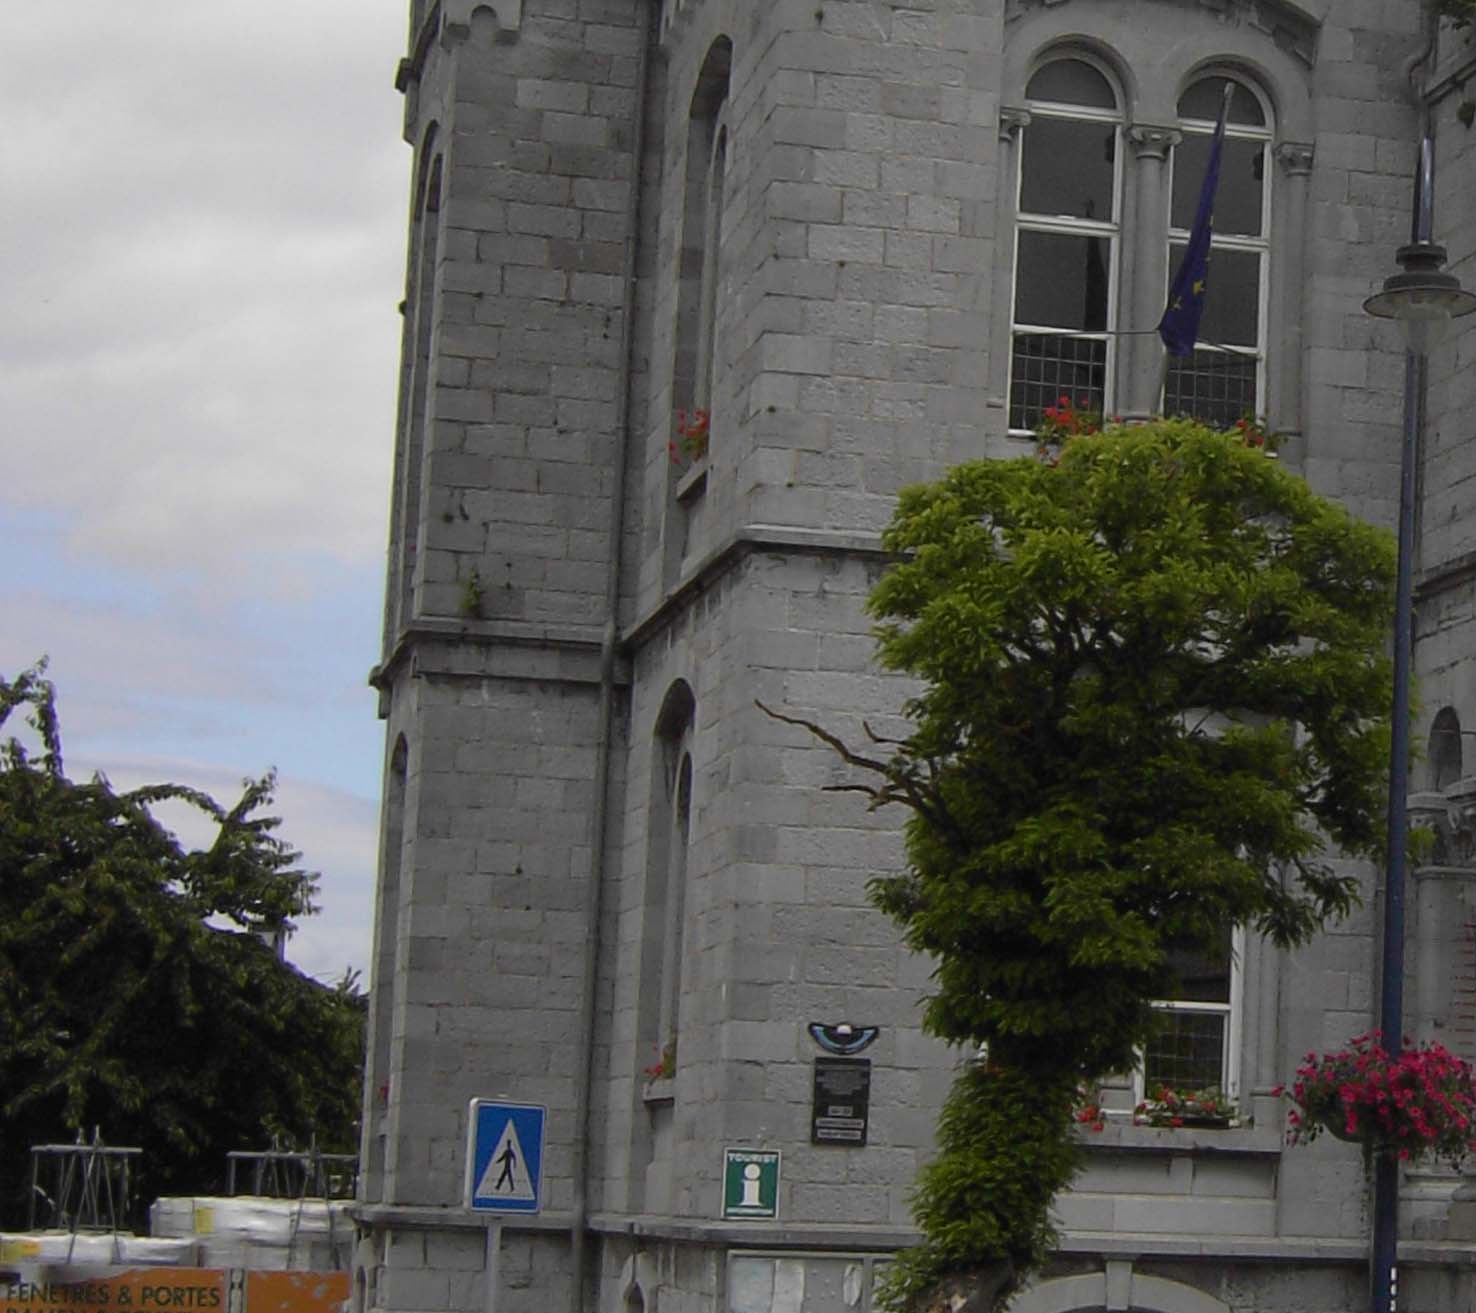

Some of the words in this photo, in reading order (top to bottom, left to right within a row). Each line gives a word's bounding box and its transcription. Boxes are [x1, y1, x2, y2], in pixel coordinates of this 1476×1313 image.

[727, 1152, 778, 1163] TOURIST
[117, 1286, 132, 1305] &
[141, 1286, 221, 1307] PORTES
